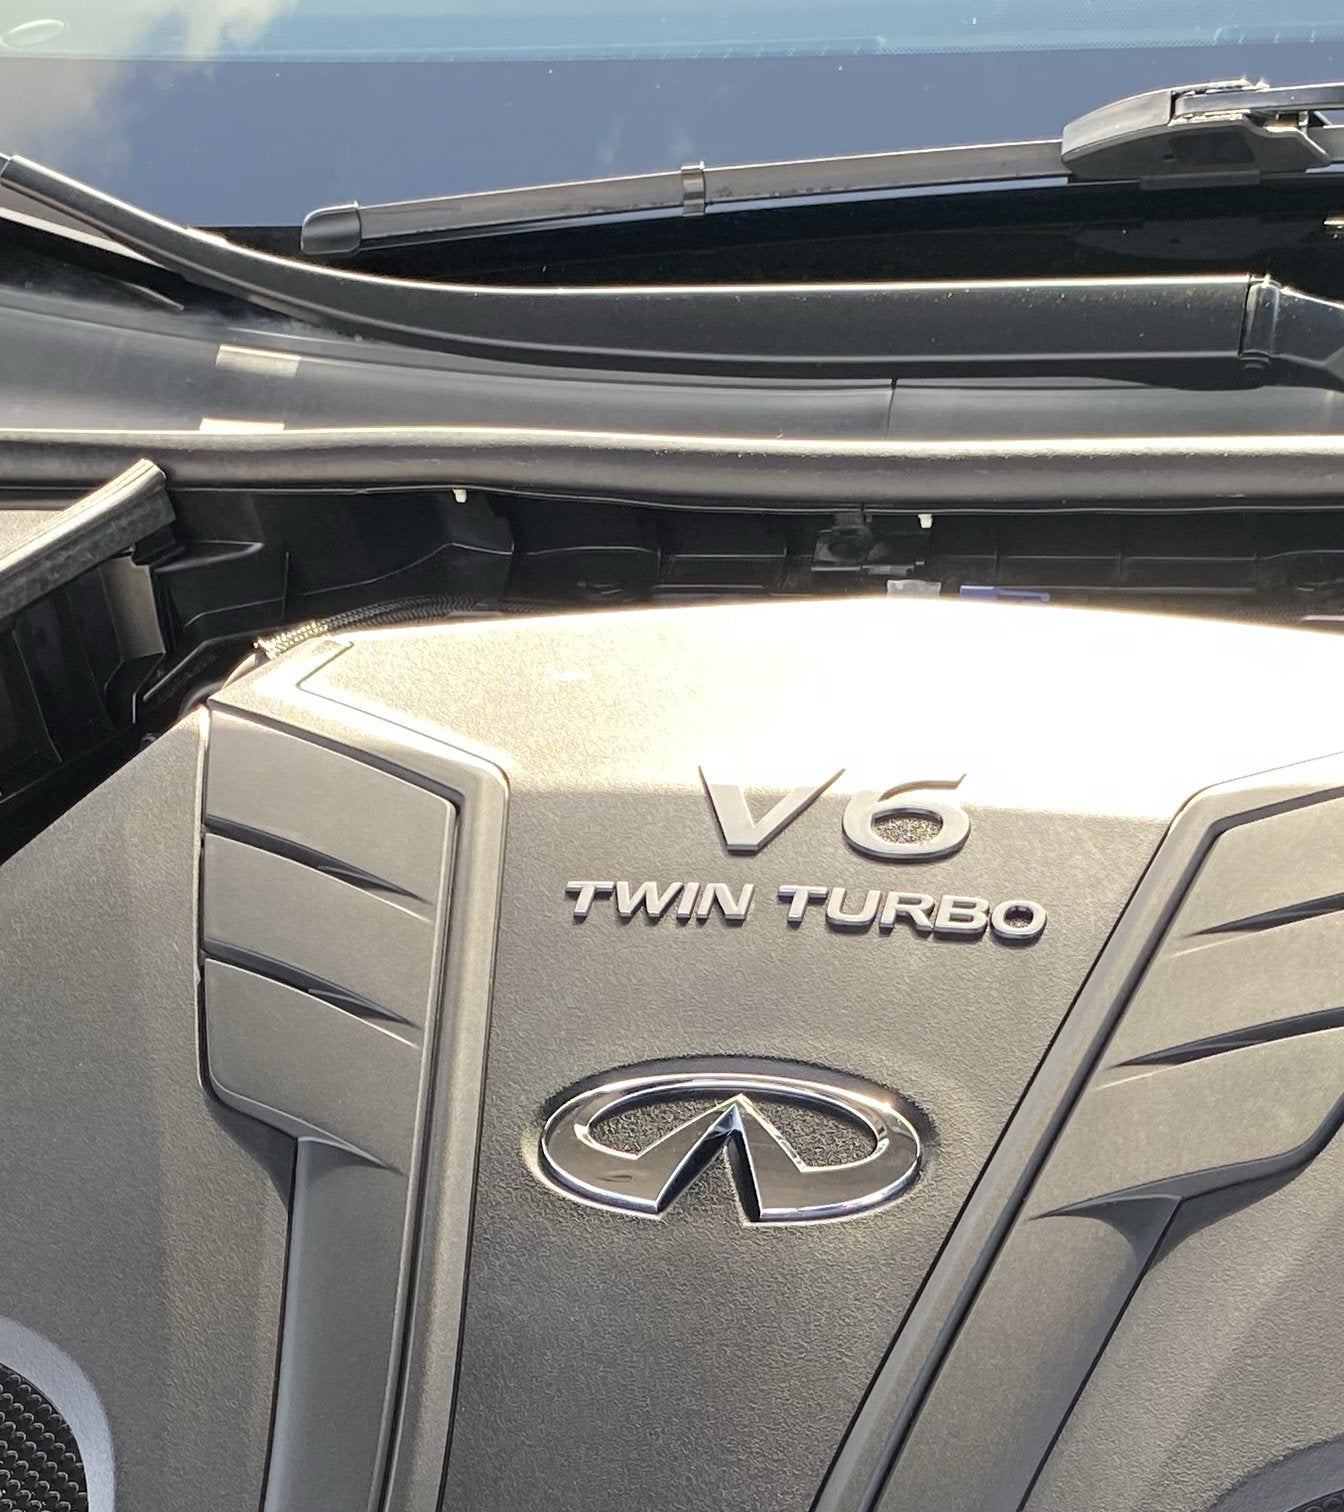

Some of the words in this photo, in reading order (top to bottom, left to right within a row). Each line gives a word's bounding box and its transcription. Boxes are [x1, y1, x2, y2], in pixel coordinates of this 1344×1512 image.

[698, 764, 972, 863] V6
[565, 880, 755, 924] TWIN
[777, 884, 1048, 942] TURBO
